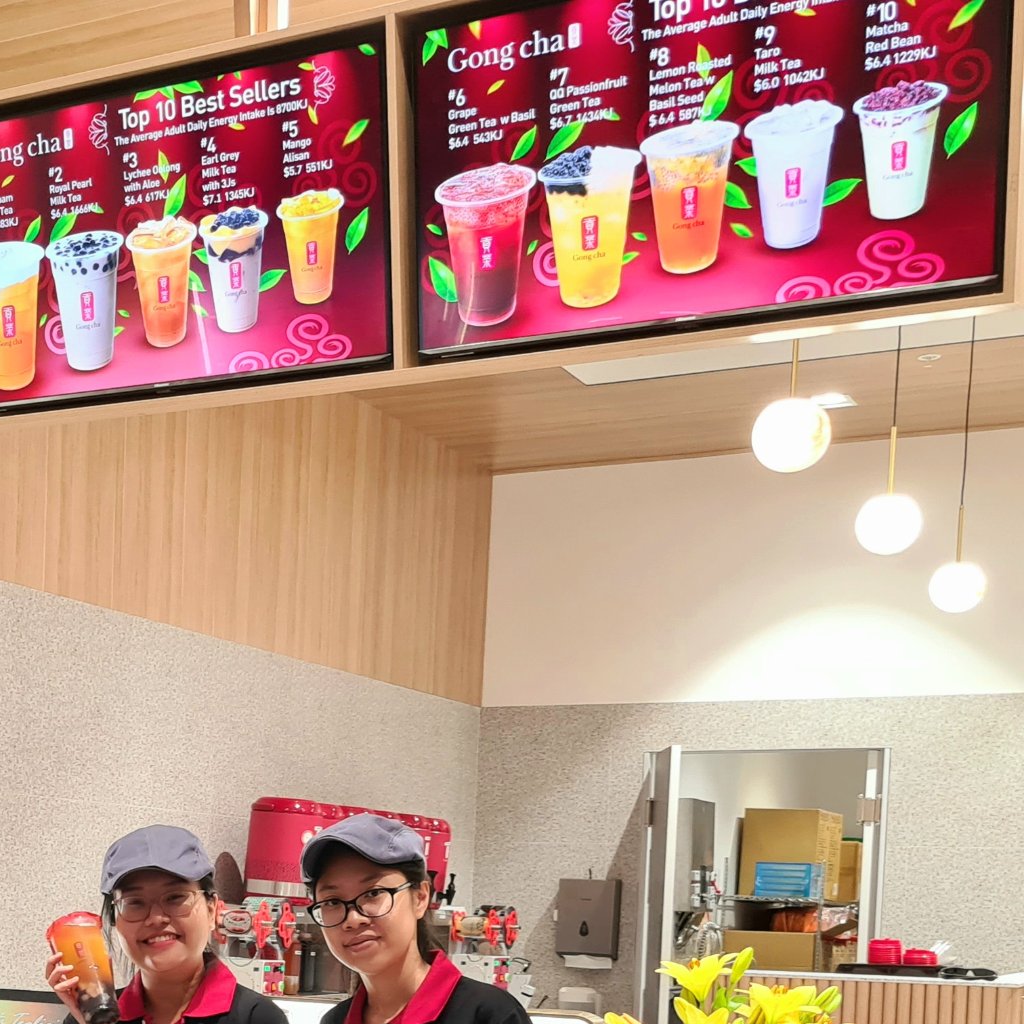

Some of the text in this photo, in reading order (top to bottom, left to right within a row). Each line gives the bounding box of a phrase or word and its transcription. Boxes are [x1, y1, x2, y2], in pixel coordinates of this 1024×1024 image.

[641, 28, 661, 41] The
[663, 20, 707, 38] Average
[709, 14, 739, 29] Adult
[740, 5, 768, 22] Daily
[770, 0, 810, 15] Energy
[648, 0, 691, 22] Top
[866, 1, 897, 23] #10
[754, 25, 776, 46] #9
[865, 21, 909, 38] Matcha
[447, 42, 516, 73] Gong
[519, 30, 565, 58] cha
[865, 34, 922, 54] Red Bean
[649, 47, 669, 67] #8
[754, 47, 782, 61] Taro
[864, 45, 937, 72] $6.4 1229KJ
[649, 53, 732, 81] Lemon Roasted
[754, 58, 802, 76] Milk Tea
[550, 67, 569, 87] #7
[754, 67, 825, 93] $6.0 1042KJ
[550, 75, 628, 100] QQ Passionfruit
[649, 82, 682, 97] Melon
[683, 77, 703, 90] Tea
[118, 77, 301, 132] Top 10 Best Sellers
[448, 88, 466, 107] #6
[550, 97, 601, 115] Green Tea
[649, 90, 704, 112] Basil Seed
[114, 99, 308, 146] The Average Adult Daily Energy Intake Is 8700KJ
[448, 107, 478, 121] Grape
[448, 108, 536, 135] Green Tea w Basil
[282, 120, 298, 138] #5
[27, 133, 61, 156] cha
[200, 137, 216, 153] #4
[282, 138, 312, 151] Mango
[448, 129, 504, 150] $6.4 543KJ
[123, 152, 138, 168] #3
[201, 152, 240, 166] Earl Grey
[283, 151, 310, 164] Alisan
[49, 167, 63, 182] #2
[123, 162, 181, 181] Lychee Oolong
[202, 165, 237, 179] Milk Tea
[283, 159, 333, 178] $5.7 551KJ
[49, 178, 92, 196] Royal Pearl
[124, 179, 160, 193] with Aloe
[202, 178, 236, 192] with 3Js
[50, 193, 81, 206] Milk Tea
[125, 194, 143, 206] $6.4
[202, 187, 255, 206] $7.1 1345KJ
[0, 206, 13, 216] Tea
[573, 251, 606, 262] Gong cha
